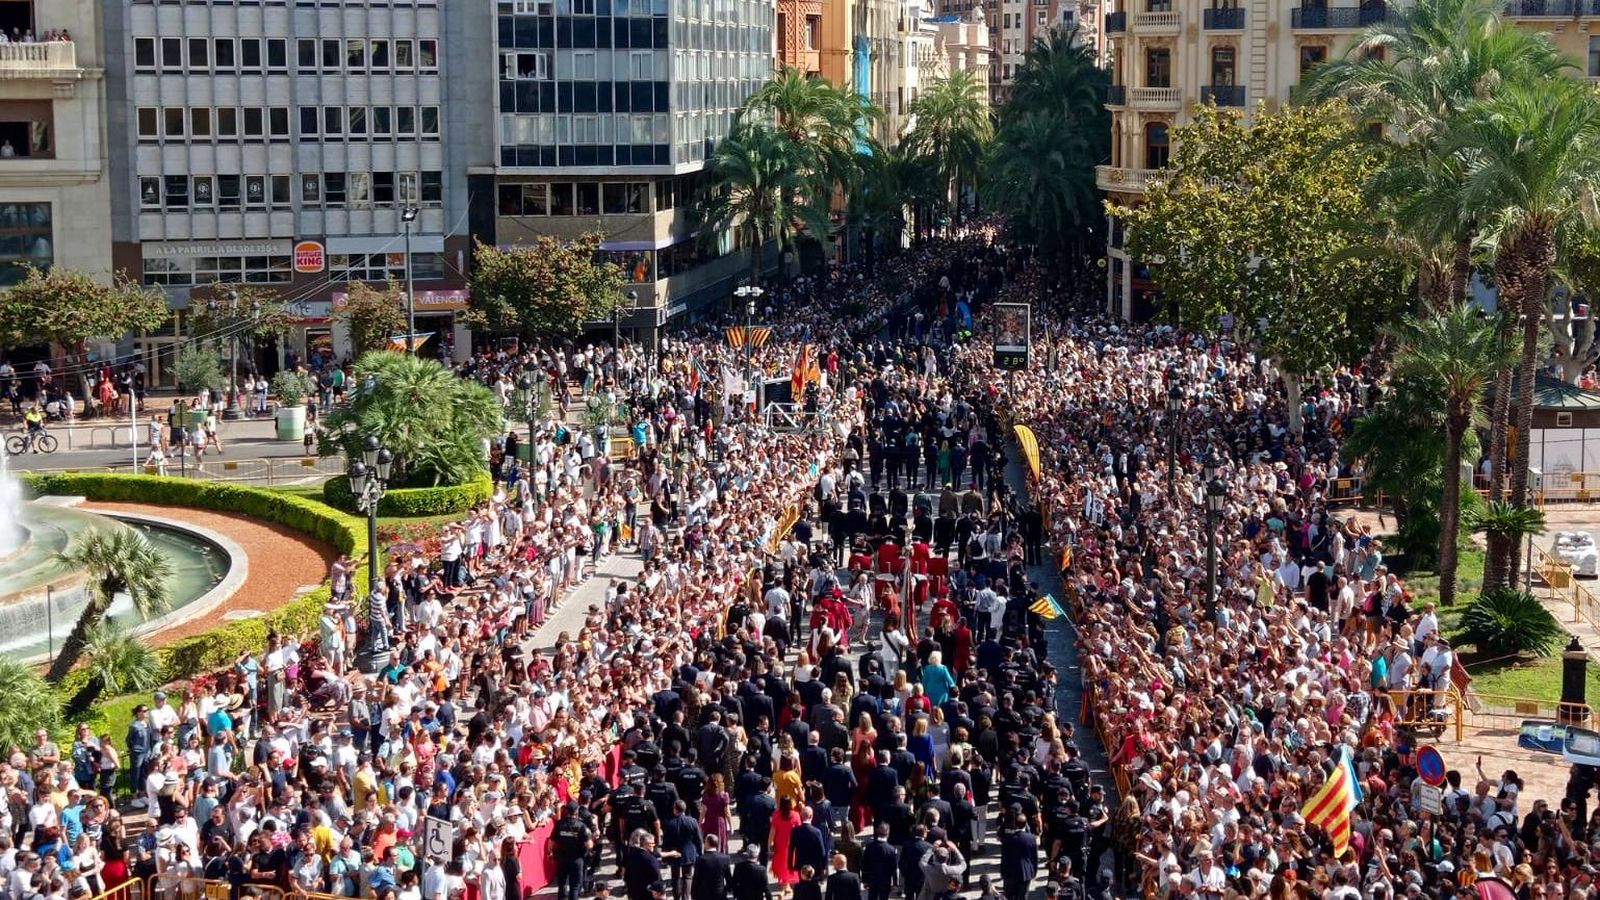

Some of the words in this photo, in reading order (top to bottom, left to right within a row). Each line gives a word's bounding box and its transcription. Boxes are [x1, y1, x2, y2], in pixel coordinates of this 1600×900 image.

[178, 246, 225, 254] PARRILLA
[296, 257, 322, 266] KING
[419, 295, 465, 305] VALENCIA
